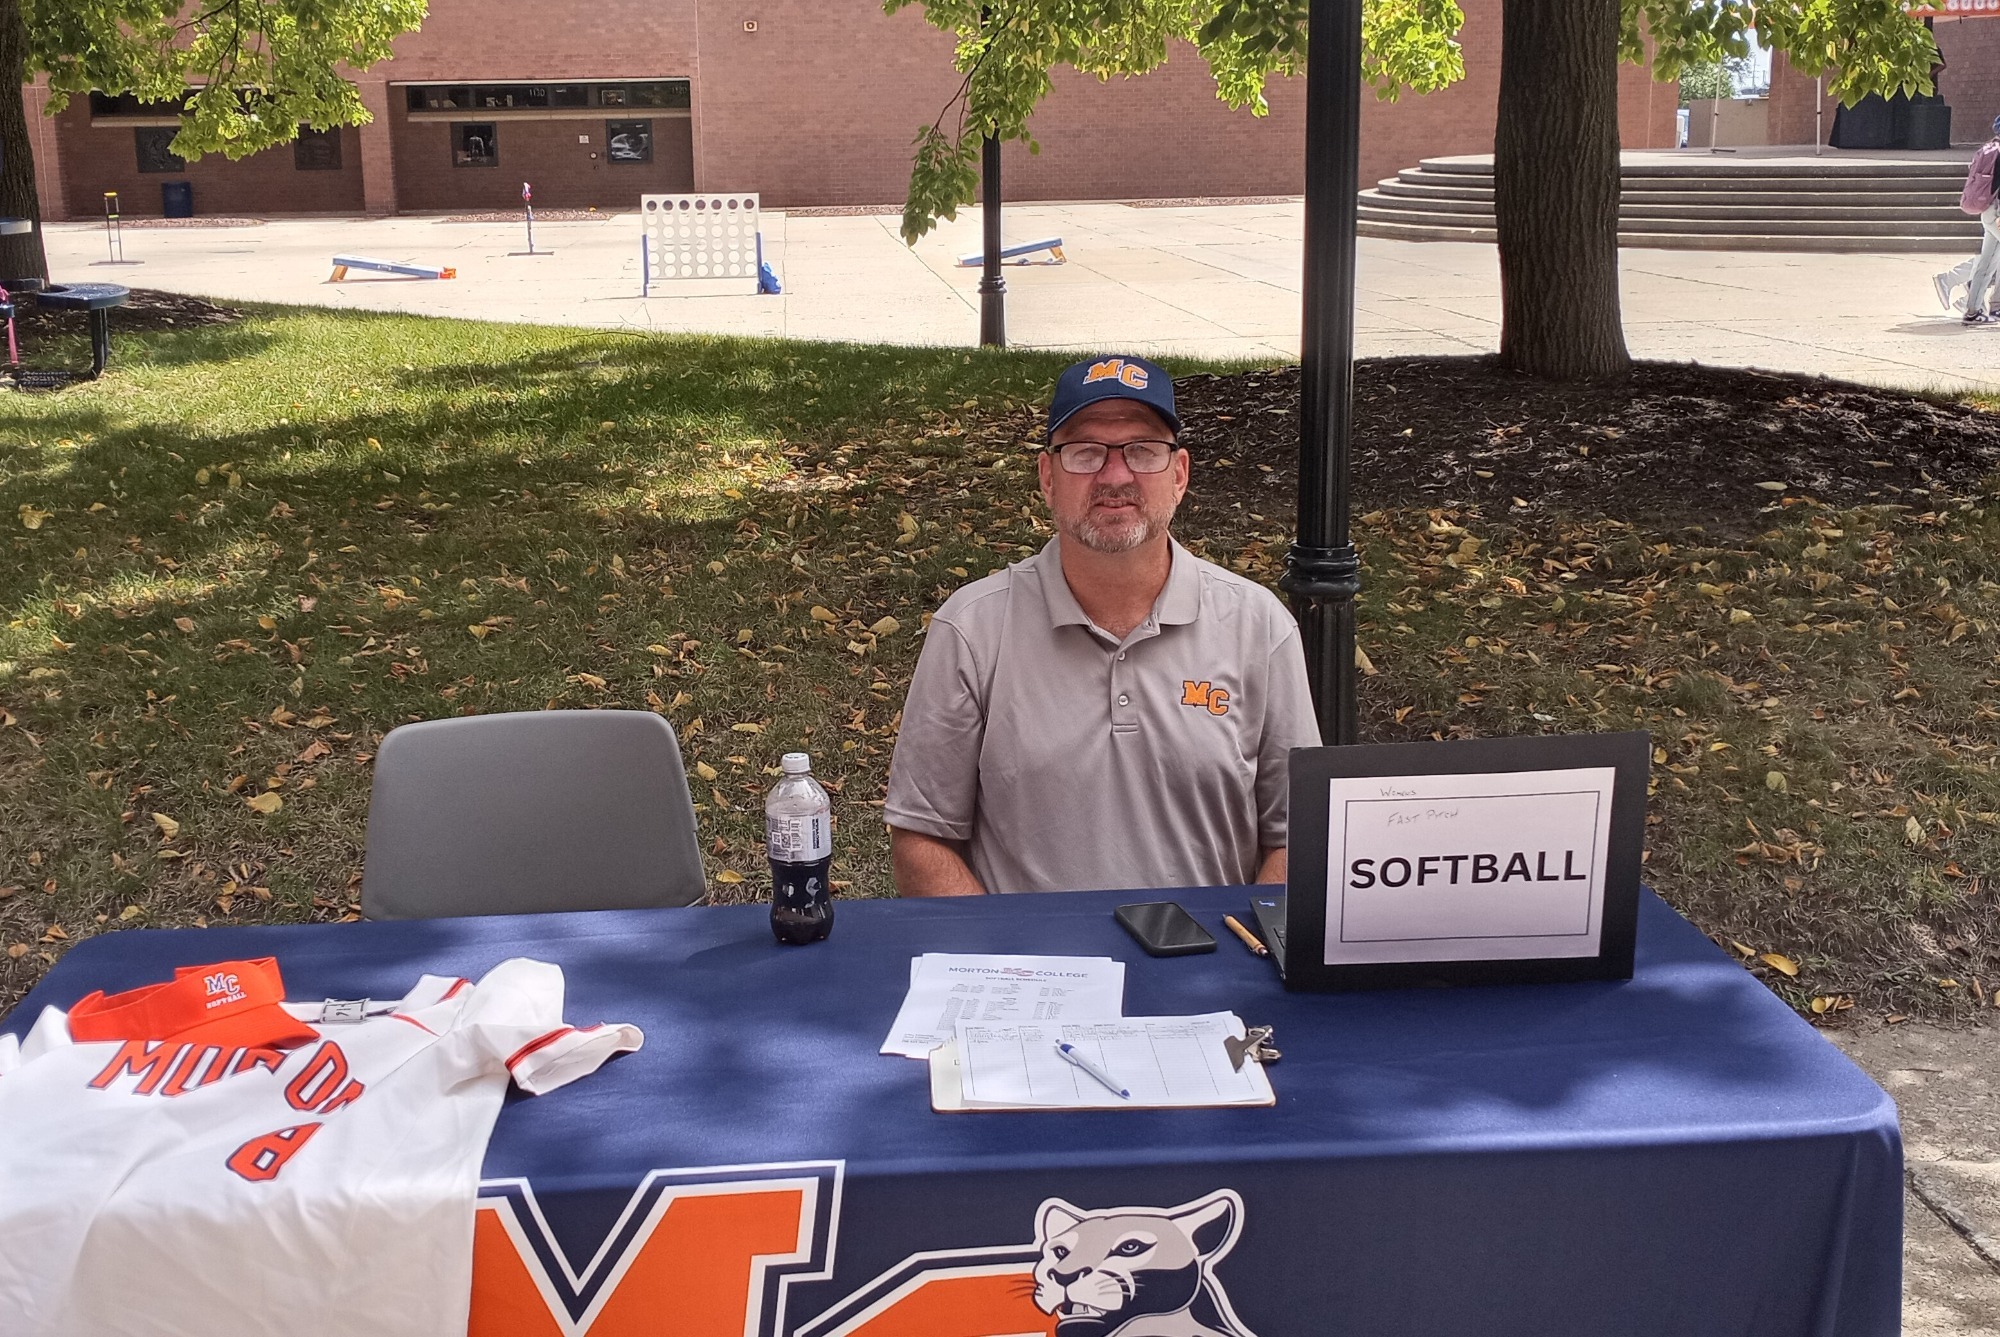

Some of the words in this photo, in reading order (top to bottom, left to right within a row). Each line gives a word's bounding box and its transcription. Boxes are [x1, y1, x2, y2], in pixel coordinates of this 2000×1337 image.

[1083, 359, 1148, 389] MC
[1181, 680, 1230, 716] MC
[1349, 850, 1587, 890] SOFTBALL
[204, 973, 240, 996] MC
[1035, 970, 1088, 978] COLLEGE
[206, 992, 247, 1009] SOFTBALL
